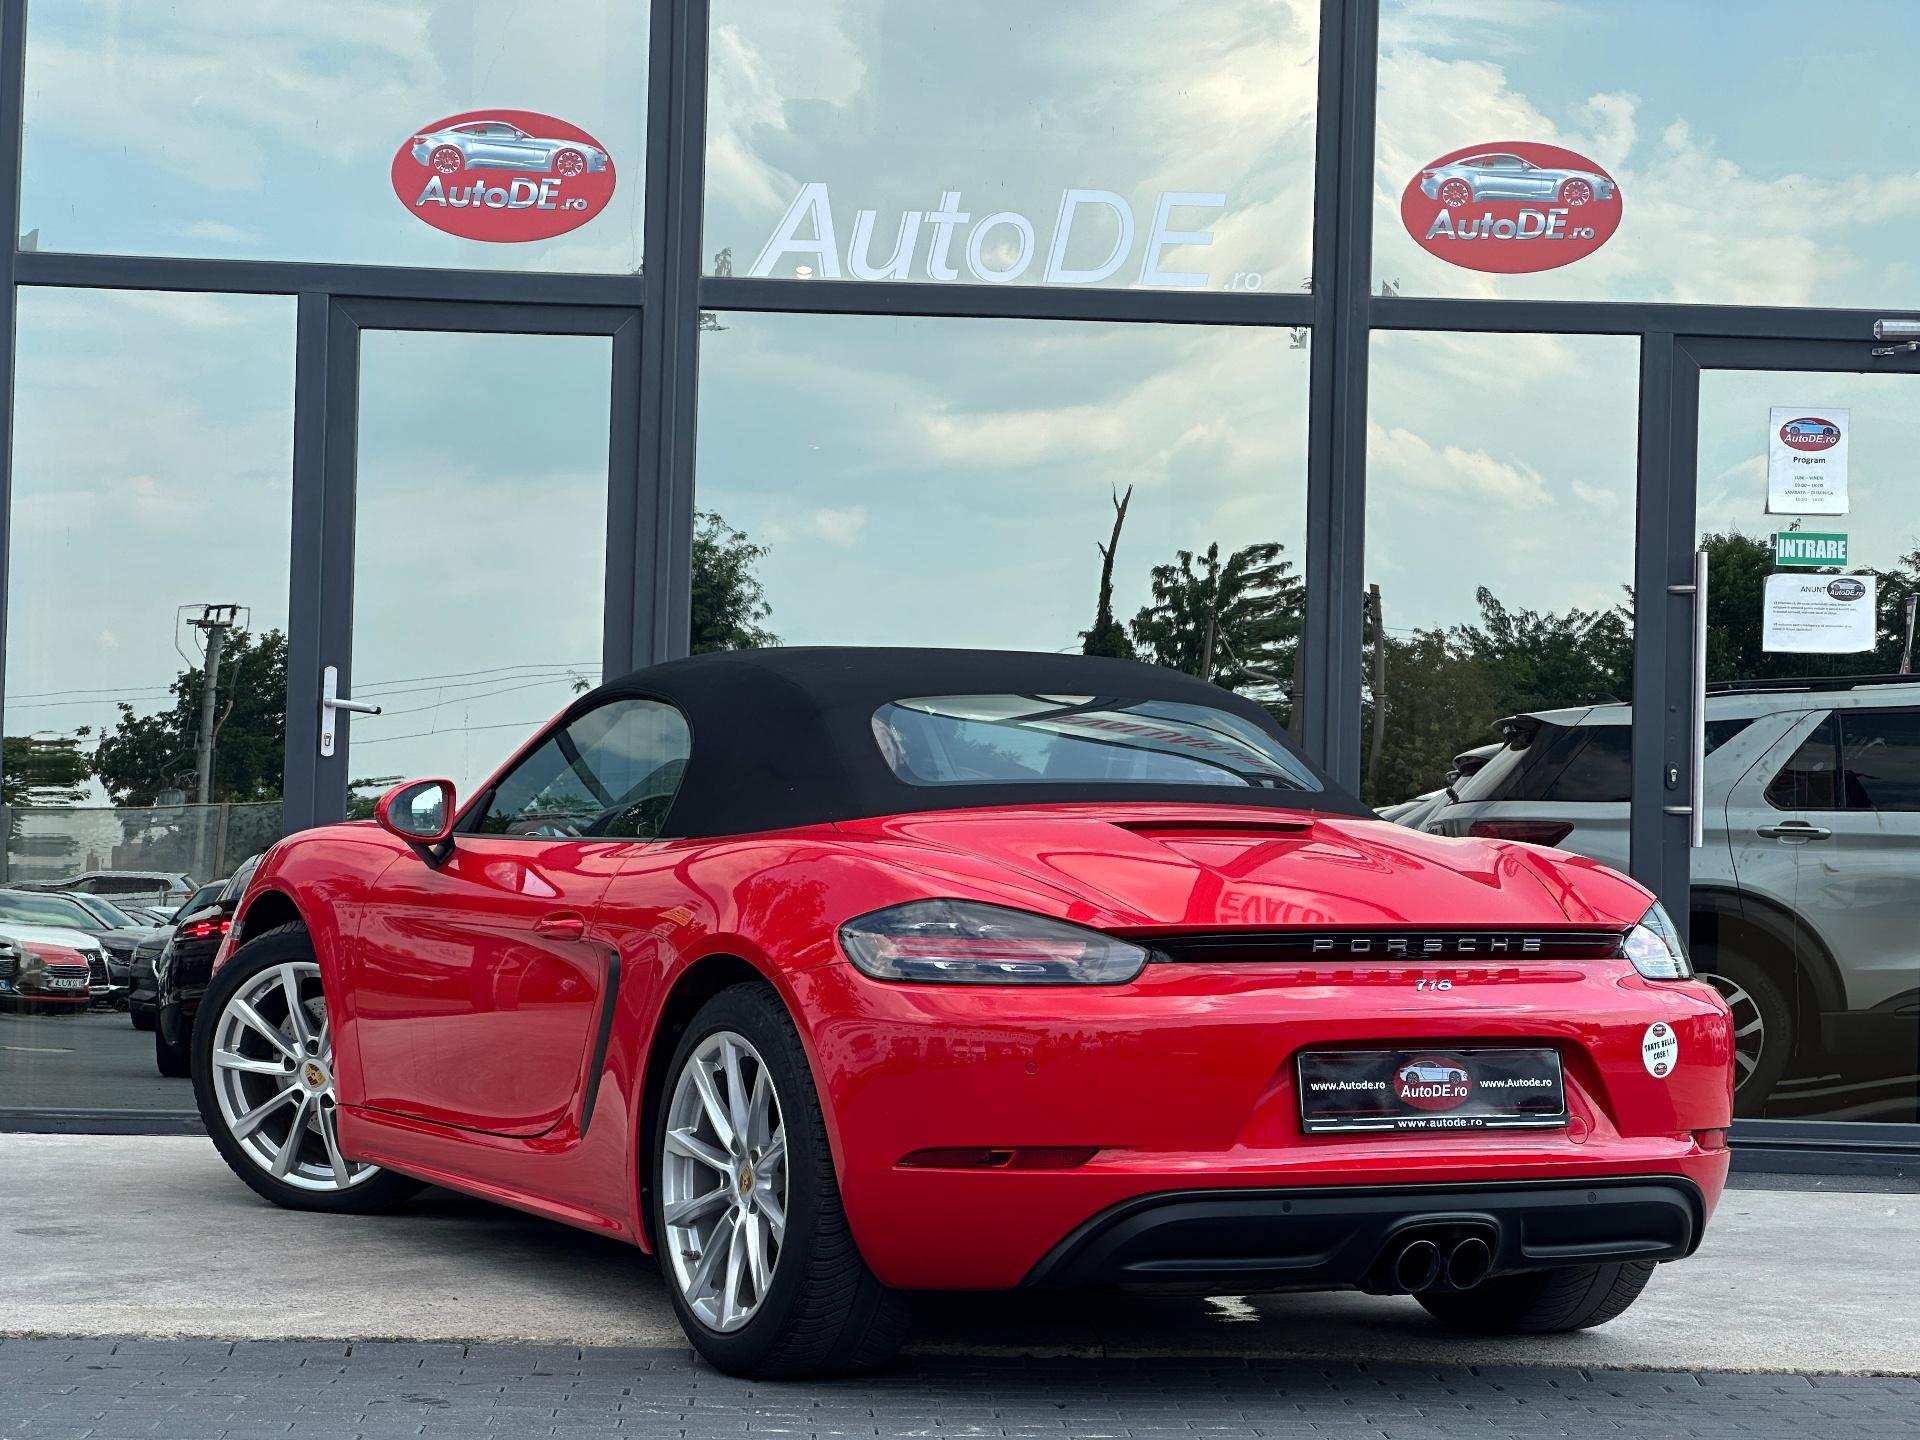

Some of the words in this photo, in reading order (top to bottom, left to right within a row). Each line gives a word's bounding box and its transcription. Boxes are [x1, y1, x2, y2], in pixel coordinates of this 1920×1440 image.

[415, 175, 588, 211] AutoDE.ro
[1425, 208, 1595, 241] AutoDE.ro
[1784, 434, 1837, 444] AutoDE.ro
[1793, 456, 1826, 465] Program
[1779, 538, 1846, 559] INTRARE
[1312, 938, 1542, 953] PORSCHE
[1414, 978, 1454, 992] 718
[1310, 1080, 1386, 1091] www.Autode.ro
[1479, 1077, 1552, 1088] www.Autode.ro
[1400, 1084, 1468, 1098] AutoDE.ro
[1397, 1117, 1483, 1128] www.autode.ro
